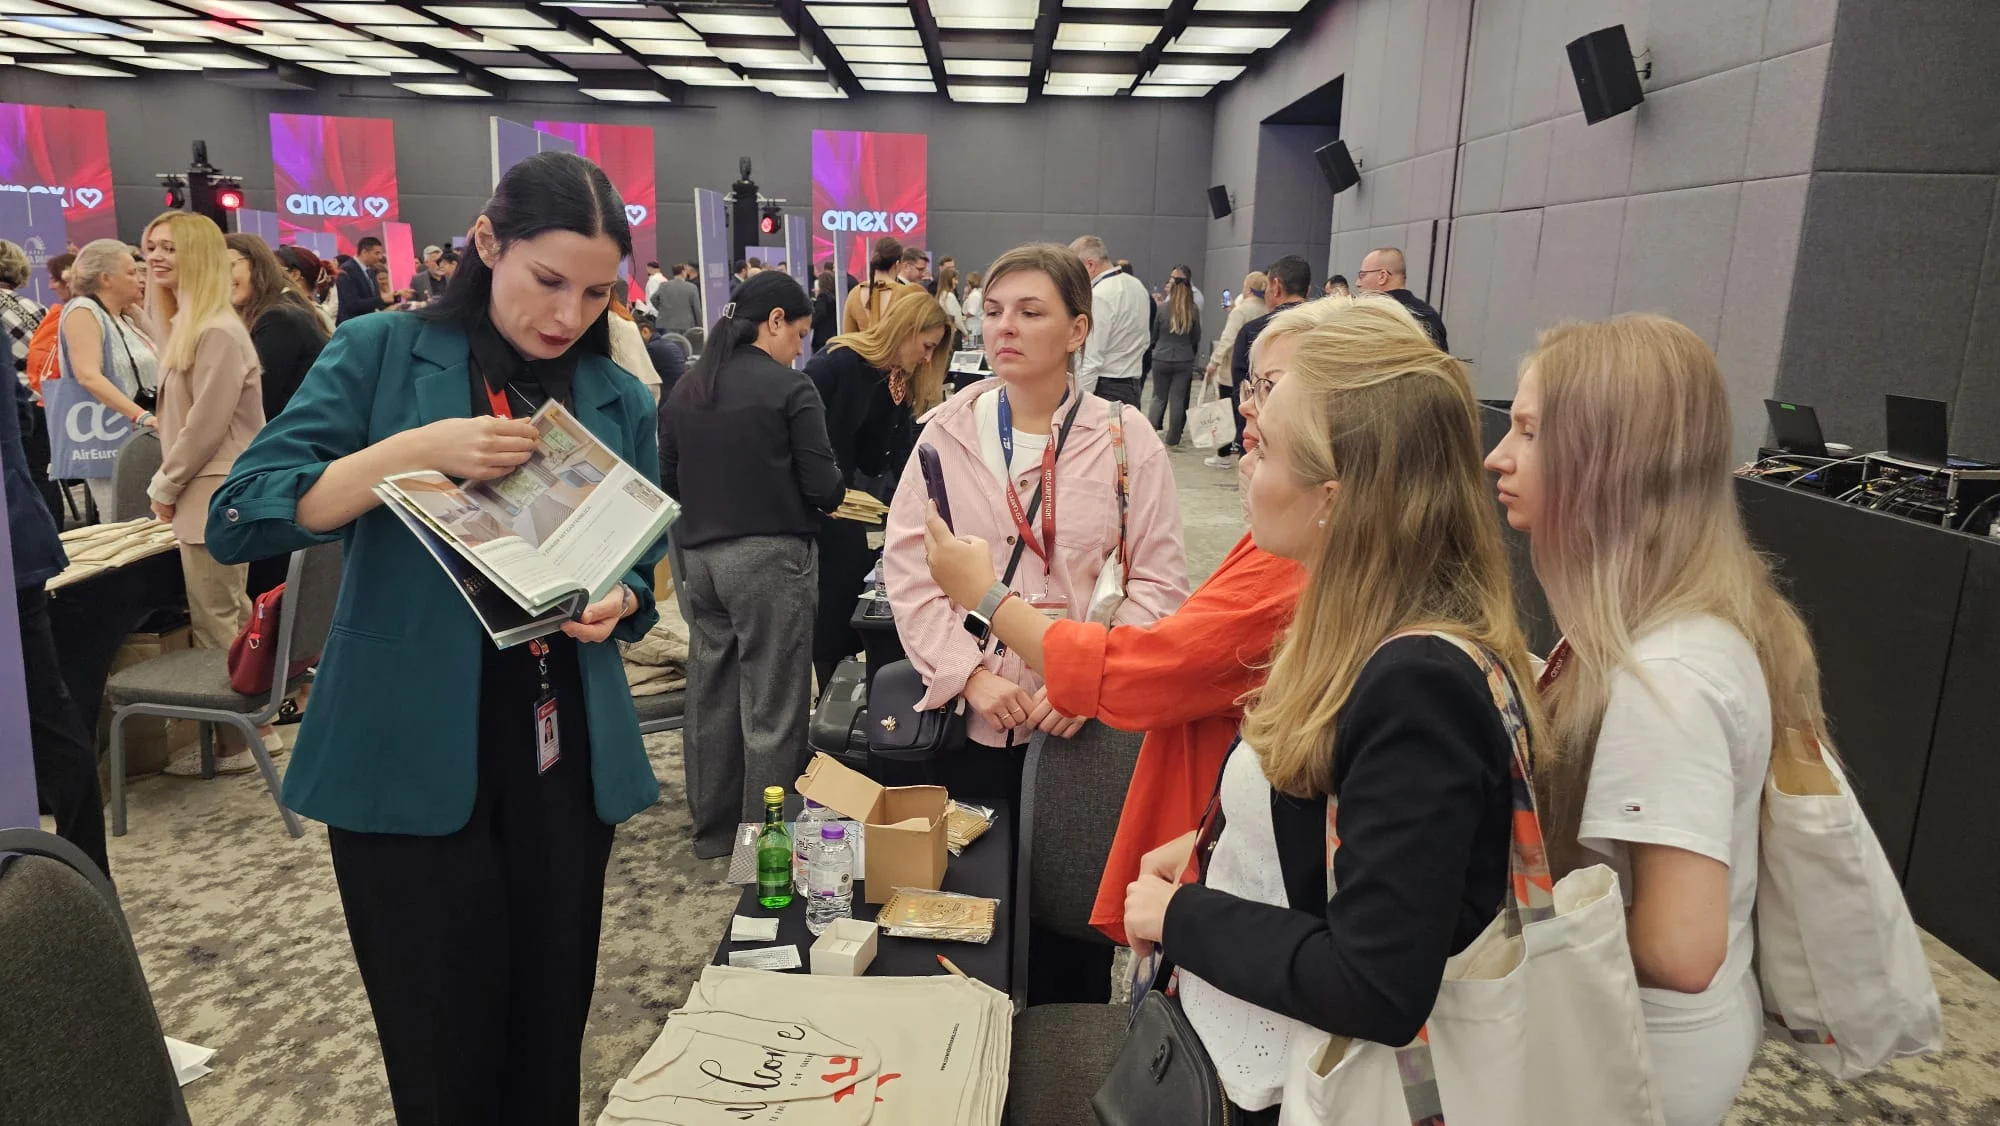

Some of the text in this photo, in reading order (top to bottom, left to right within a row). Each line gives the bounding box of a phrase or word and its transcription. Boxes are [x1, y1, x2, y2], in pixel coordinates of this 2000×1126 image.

[286, 194, 358, 216] anex
[822, 210, 888, 232] anex
[72, 449, 118, 460] AirEuro
